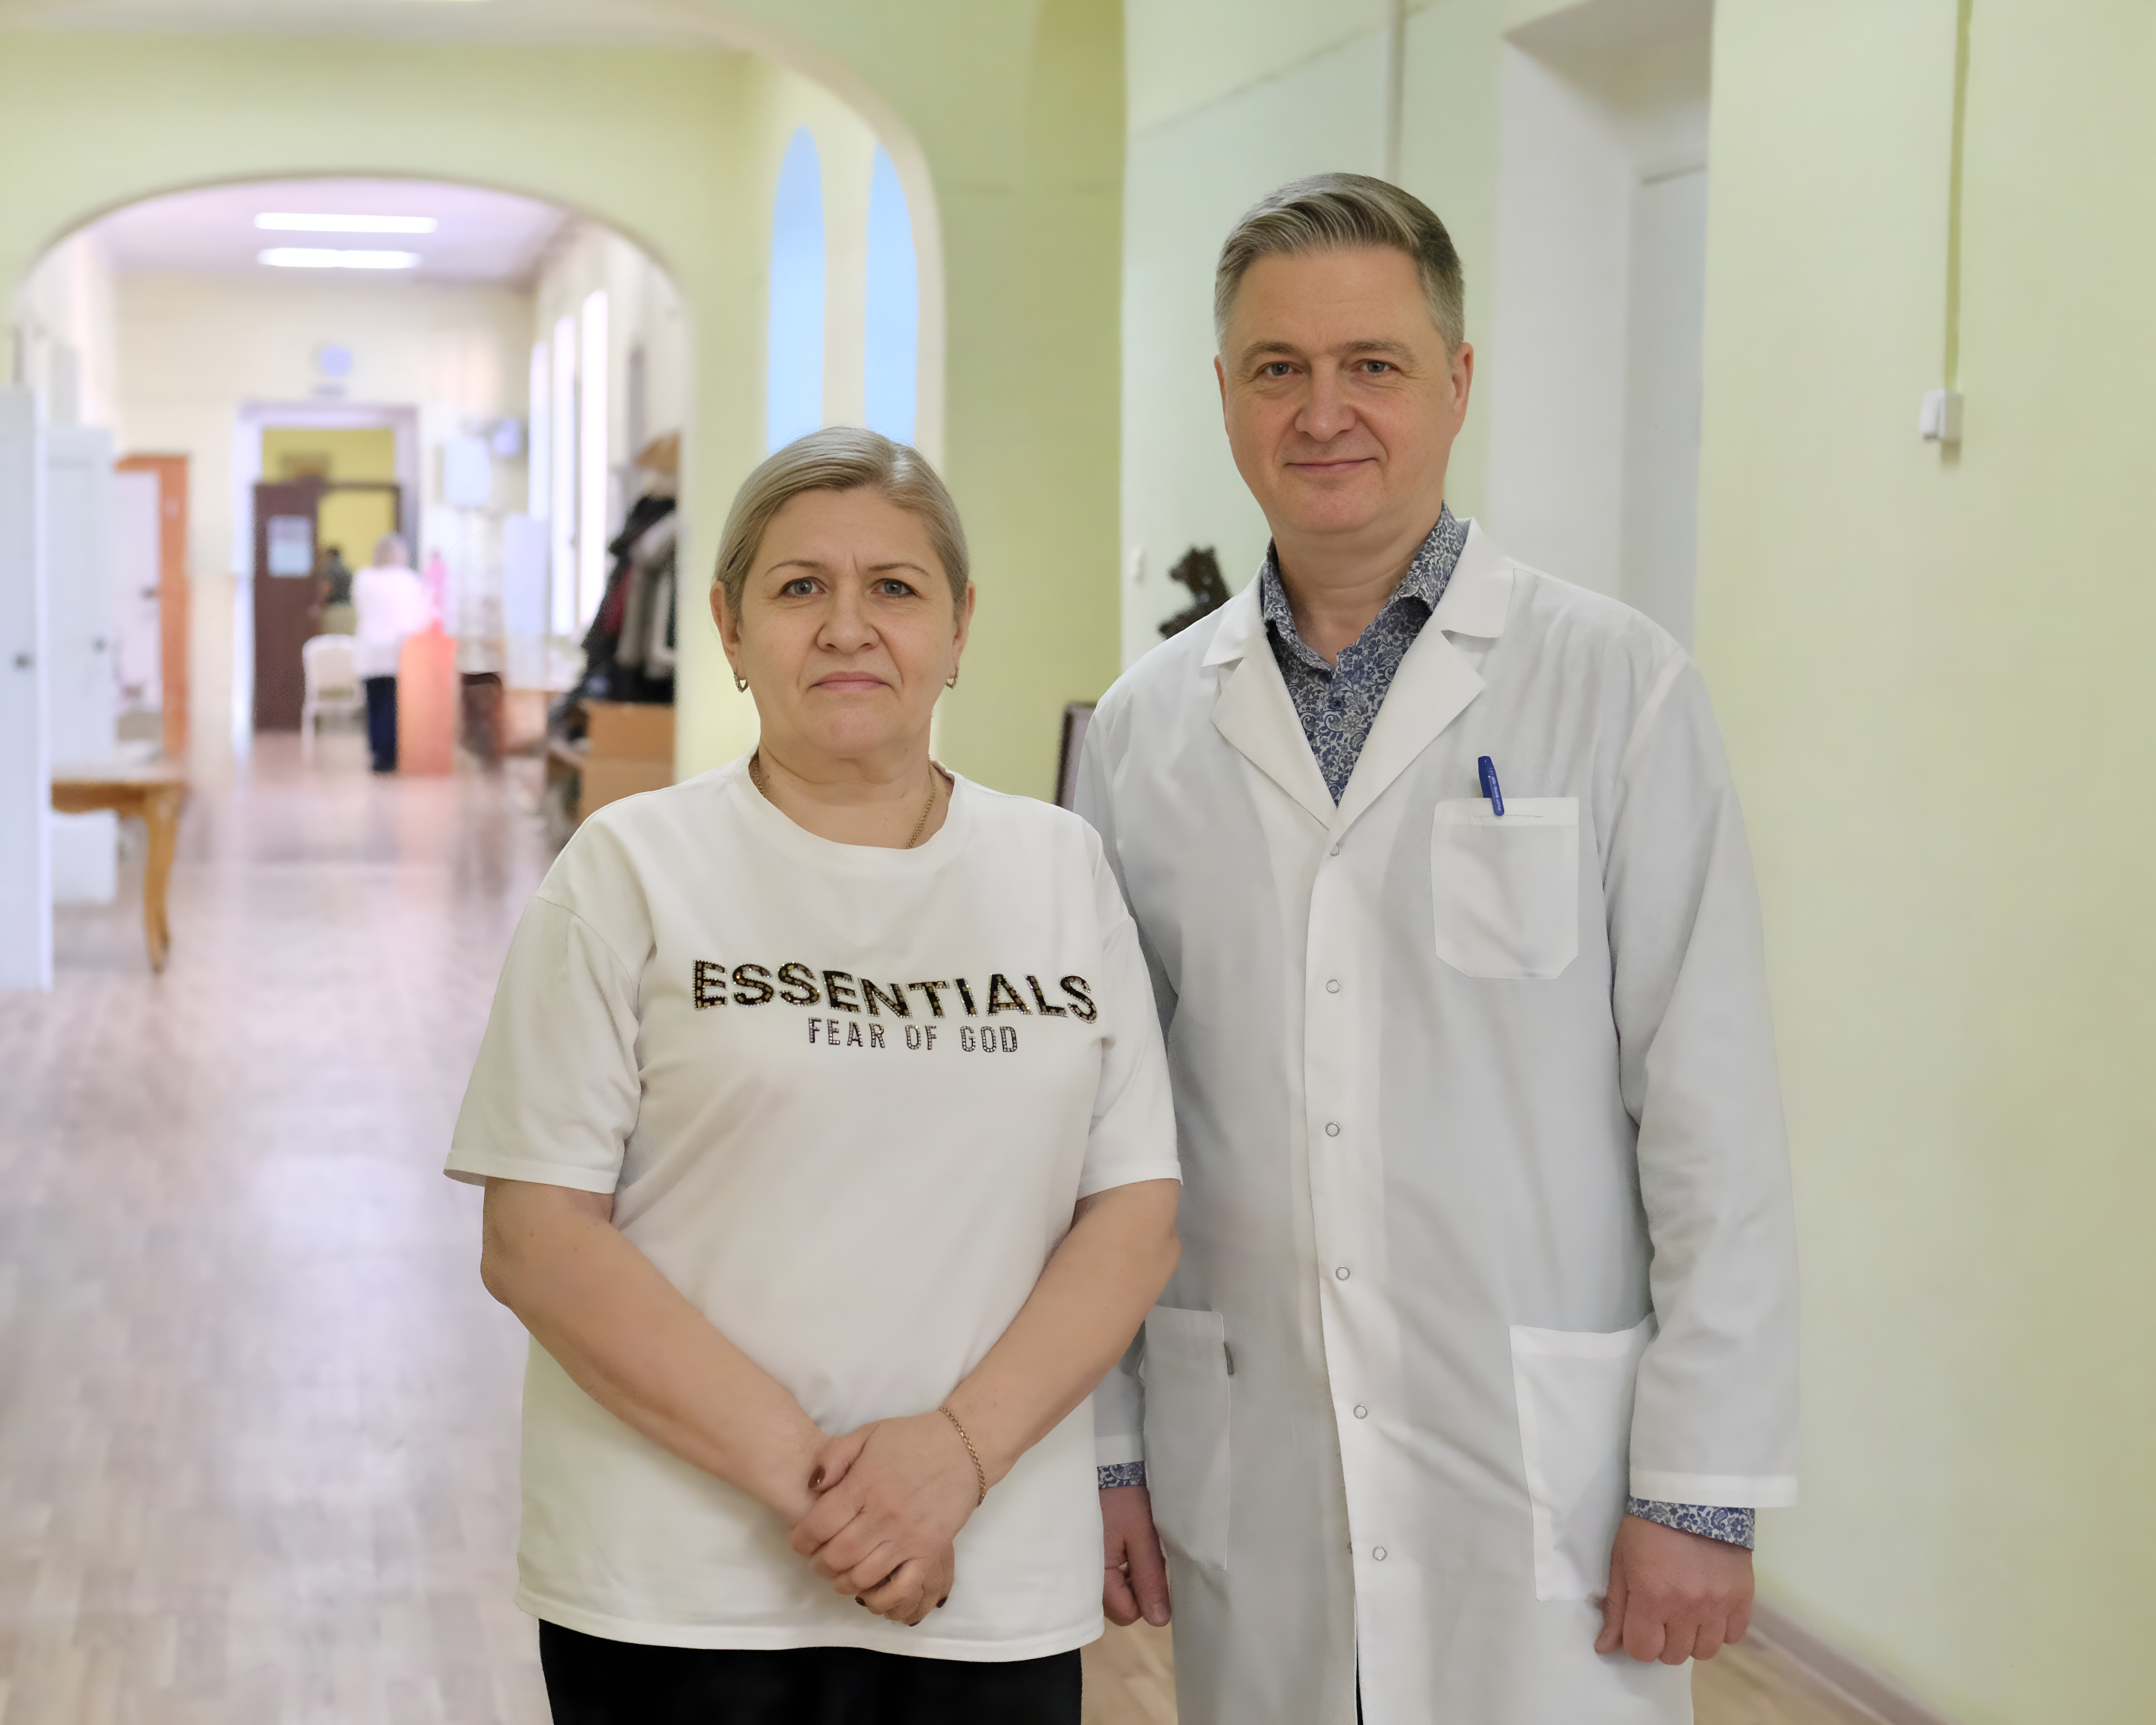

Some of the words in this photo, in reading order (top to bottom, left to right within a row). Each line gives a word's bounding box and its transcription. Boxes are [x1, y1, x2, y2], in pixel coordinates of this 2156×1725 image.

[692, 960, 1099, 1024] ESSENTIALS
[808, 1016, 885, 1049] FEAR
[905, 1024, 937, 1051] OF
[960, 1026, 1019, 1053] GOD
